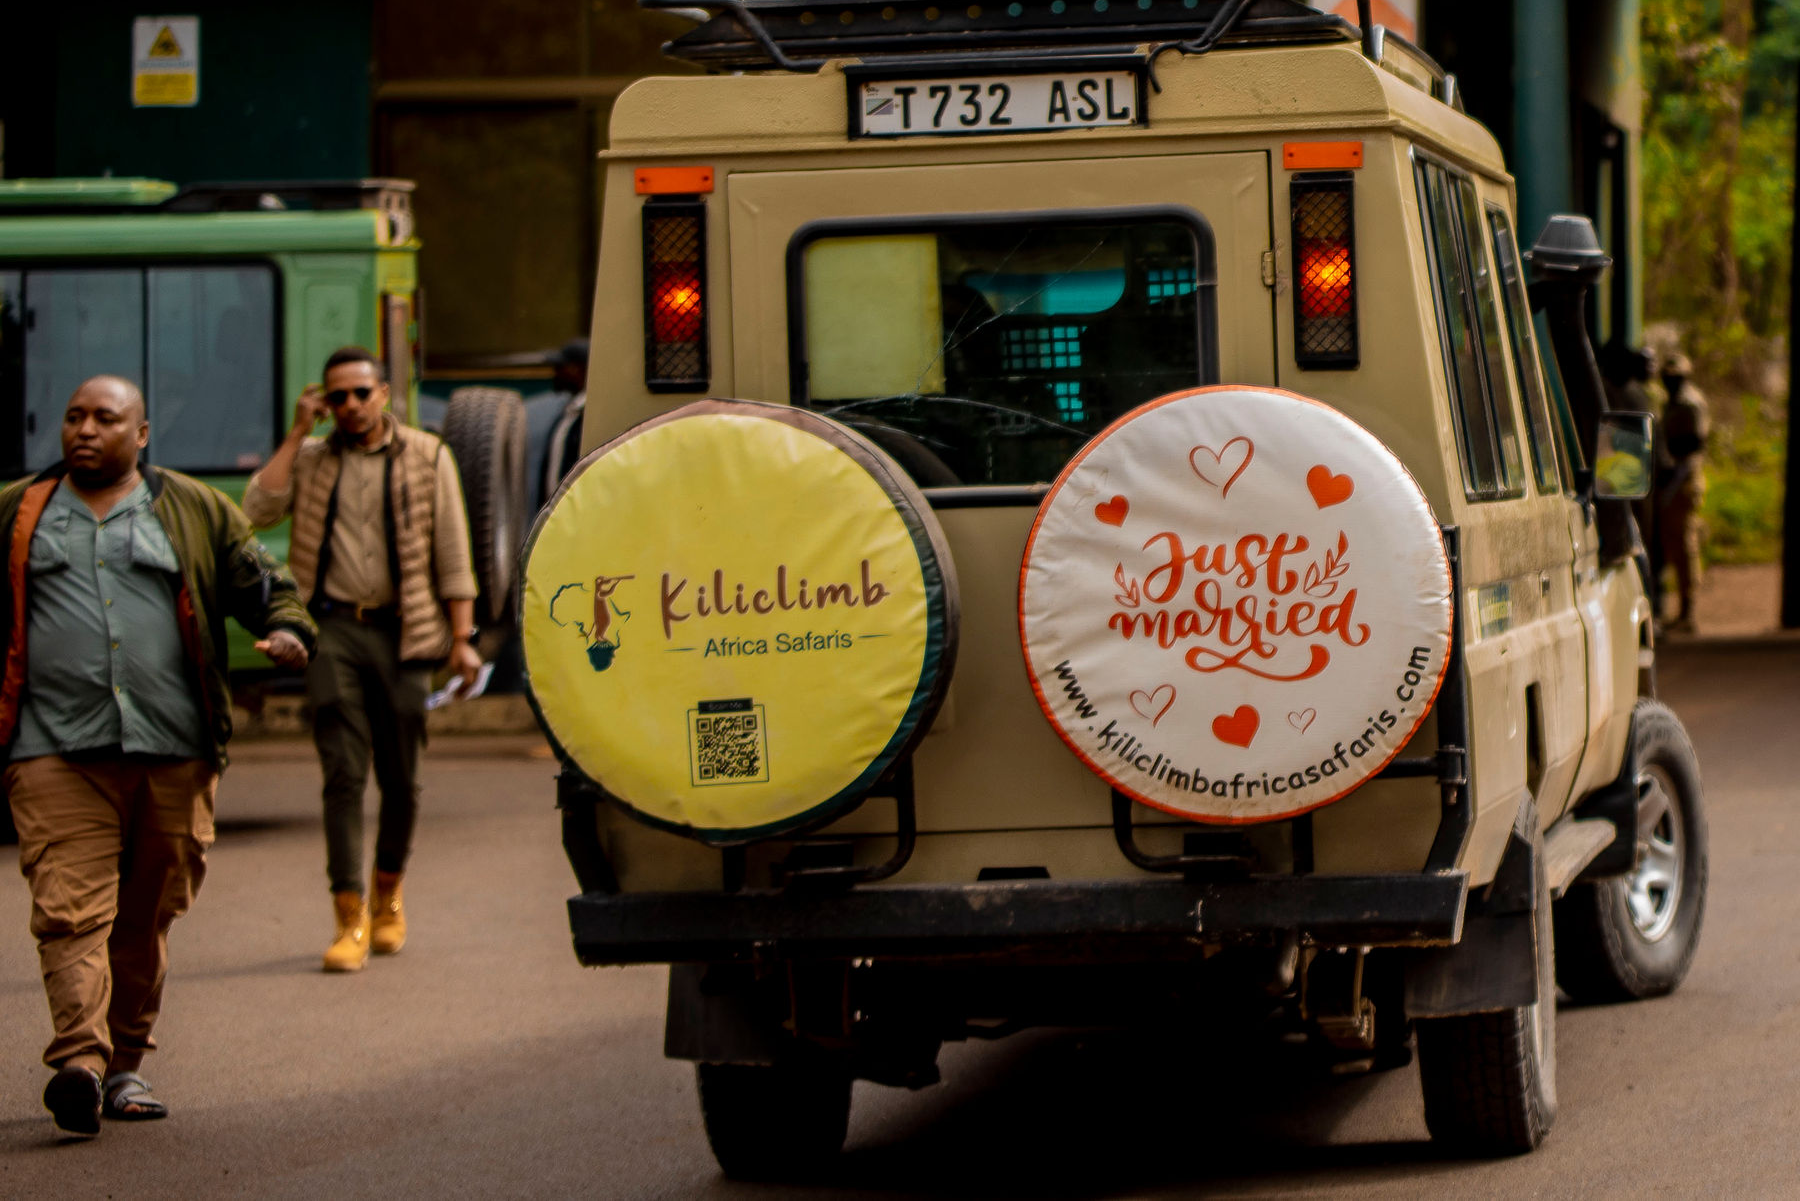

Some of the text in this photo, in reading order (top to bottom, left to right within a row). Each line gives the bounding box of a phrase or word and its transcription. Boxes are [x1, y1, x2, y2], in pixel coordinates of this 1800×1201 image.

[895, 77, 1131, 128] T732 ASL
[660, 559, 890, 641] Kiliclimb
[1142, 531, 1309, 604] Just
[703, 630, 853, 658] Africa Safaris
[1108, 578, 1372, 670] married
[1053, 644, 1431, 799] www.kiliclimbafricasafaris.com
